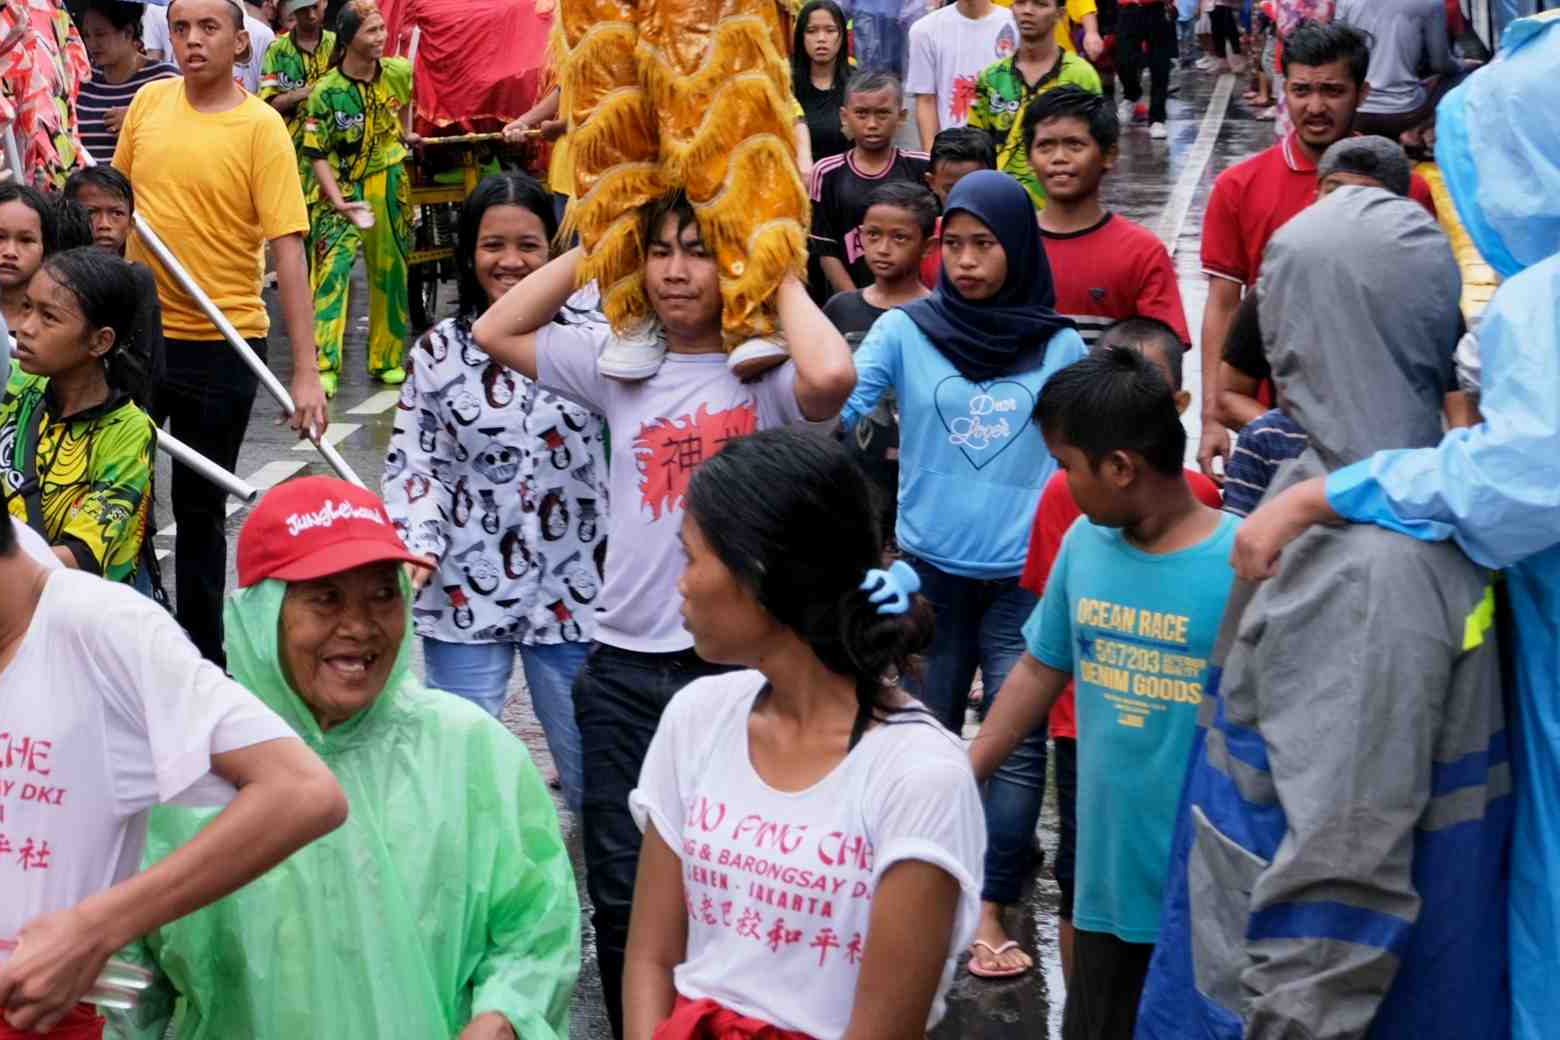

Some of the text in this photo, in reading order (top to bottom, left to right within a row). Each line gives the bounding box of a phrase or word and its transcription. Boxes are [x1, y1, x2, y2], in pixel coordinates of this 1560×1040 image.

[1077, 597, 1189, 644] OCEAN RACE
[1132, 673, 1203, 705] GOODS
[20, 783, 68, 806] DKI
[717, 849, 847, 895] BARONGSAY
[749, 880, 833, 919] JAKARTA
